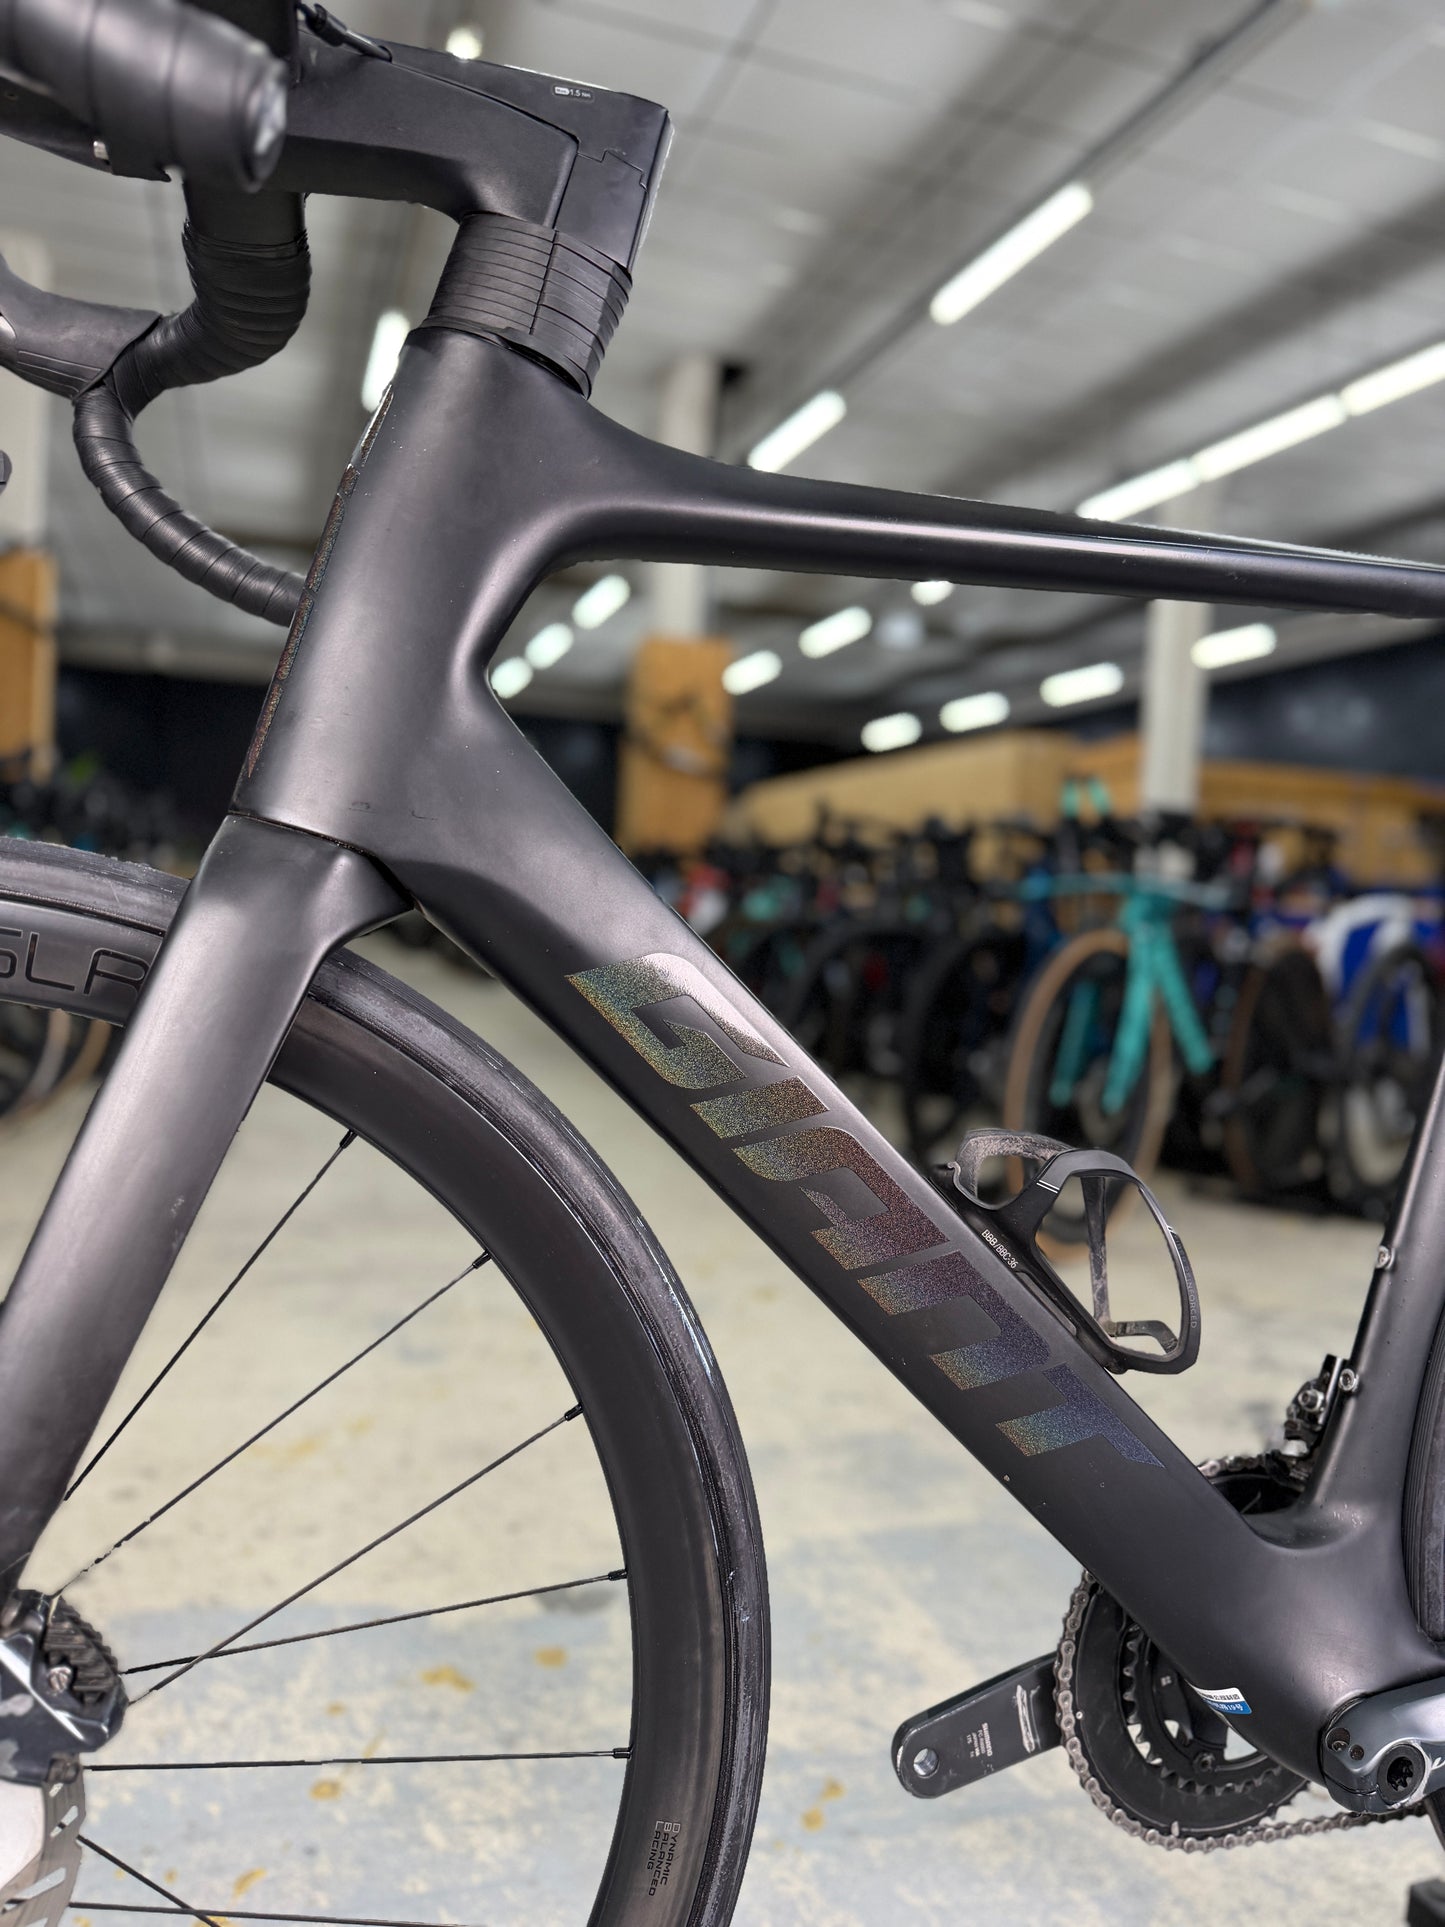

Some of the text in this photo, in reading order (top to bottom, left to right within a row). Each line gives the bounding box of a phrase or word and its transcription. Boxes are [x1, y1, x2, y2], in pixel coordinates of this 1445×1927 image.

[565, 952, 1165, 1469] GIANT
[646, 1820, 665, 1871] LACING
[648, 1821, 673, 1897] BALANCED
[660, 1822, 681, 1886] DYNAMIC
